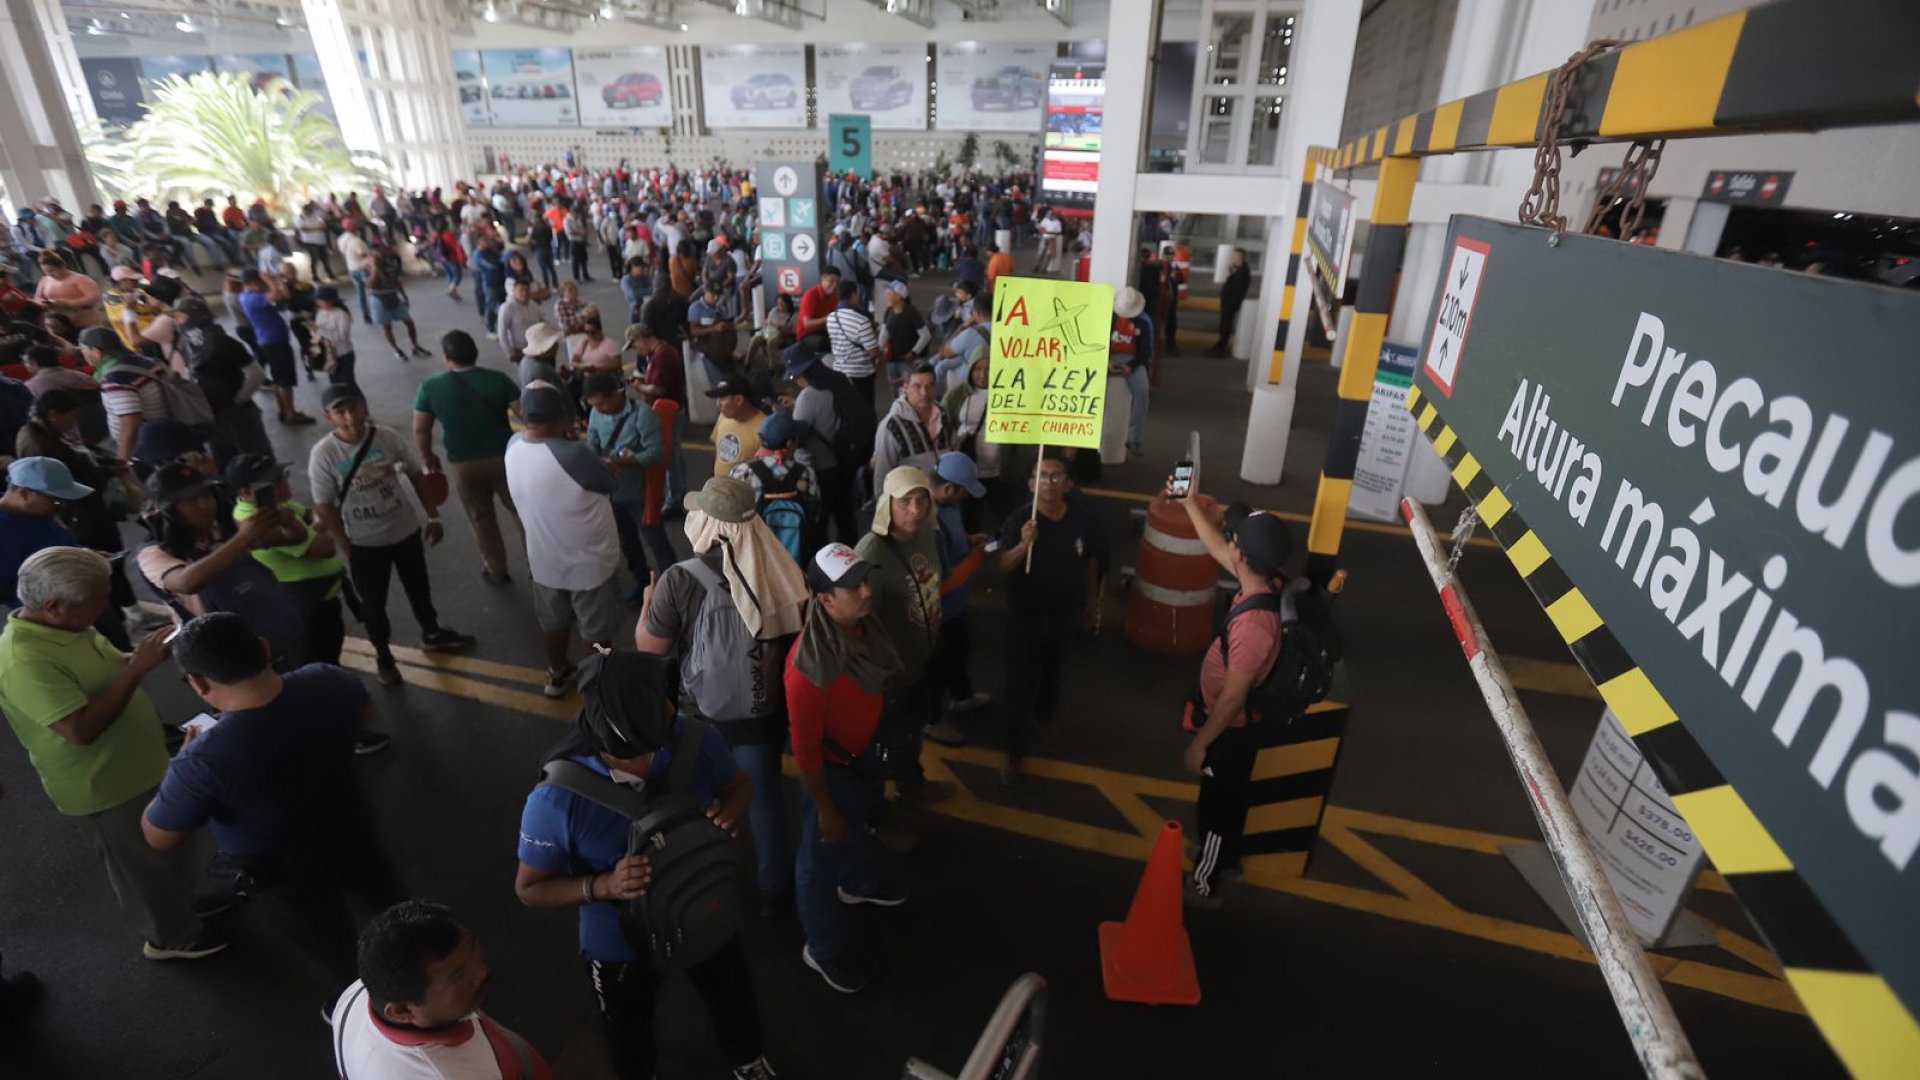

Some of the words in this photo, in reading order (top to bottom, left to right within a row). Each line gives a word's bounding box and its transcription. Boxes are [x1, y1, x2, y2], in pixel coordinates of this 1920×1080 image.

[842, 127, 862, 157] 5
[1439, 293, 1467, 339] 2.10m
[992, 367, 1026, 391] LA
[1043, 367, 1097, 393] LEY
[991, 393, 1027, 409] DEL
[1040, 394, 1101, 415] ISSSTE
[1042, 420, 1095, 436] CHIAPAS
[1498, 378, 1603, 527] Altura
[1600, 478, 1920, 871] máxima
[751, 665, 765, 715] Reebok
